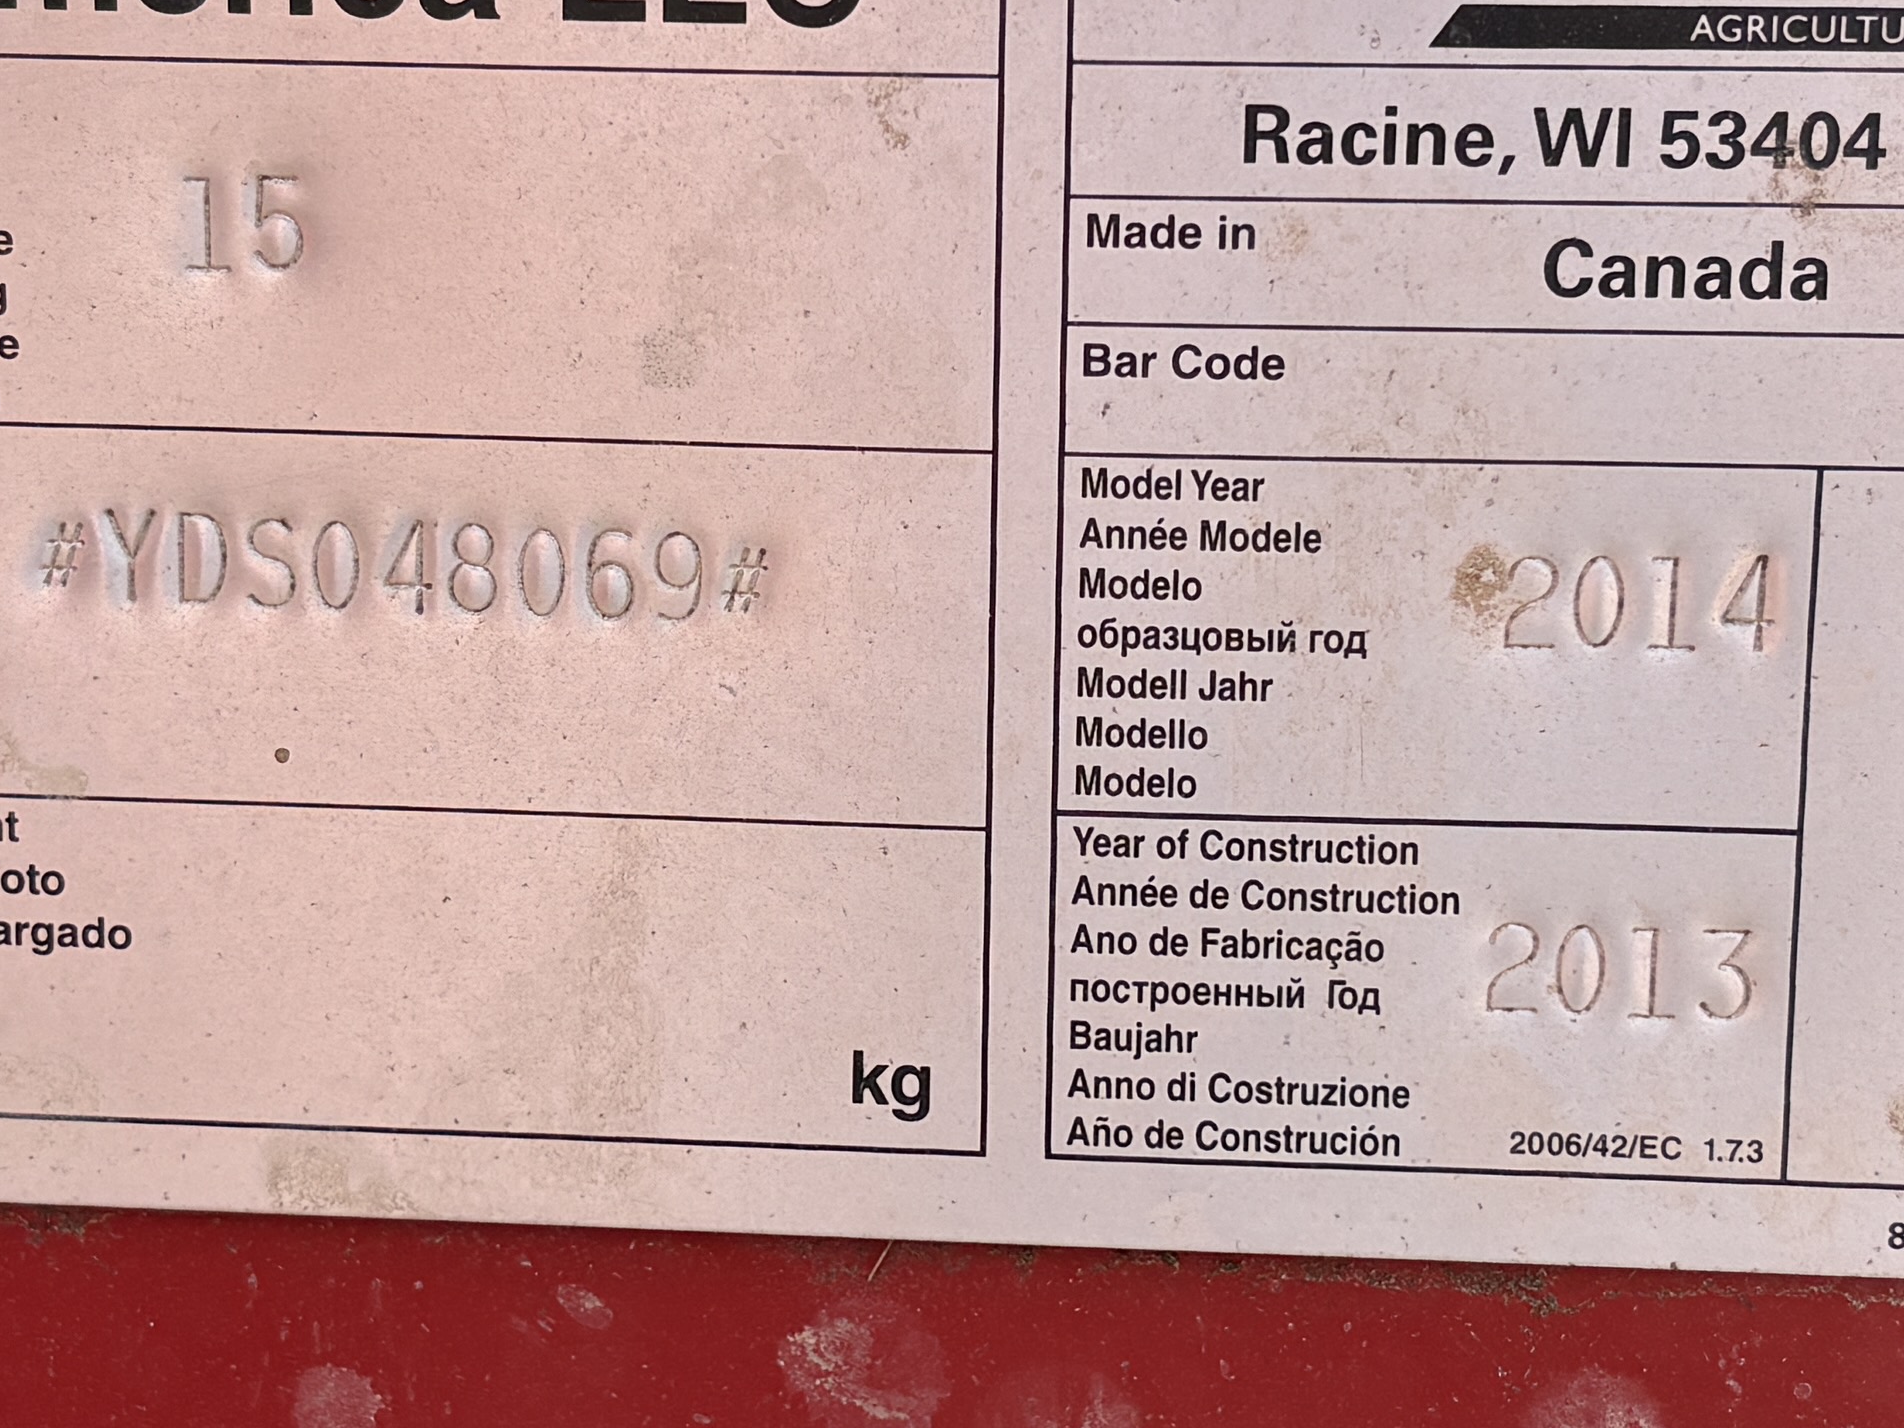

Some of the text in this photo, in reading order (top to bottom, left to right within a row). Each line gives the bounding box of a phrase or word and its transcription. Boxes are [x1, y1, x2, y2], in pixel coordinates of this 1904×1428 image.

[1242, 102, 1518, 177] Racine,
[1532, 105, 1634, 170] WI
[1658, 108, 1889, 173] 53404
[183, 174, 304, 273] 15
[1085, 211, 1257, 252] Made in
[1542, 235, 1830, 303] Canada
[1081, 341, 1287, 382] Bar Code
[1079, 462, 1267, 504] Model Year
[1077, 515, 1323, 556] Année Modele
[40, 508, 768, 620] #YDS048069#
[1077, 565, 1204, 603] Modelo
[1503, 554, 1777, 653] 2014
[1075, 615, 1372, 661] образцовый год
[1075, 664, 1275, 704] Modell Jahr
[1074, 714, 1210, 752] Modello
[1073, 762, 1198, 801] Modelo
[1071, 824, 1420, 867] Year of Construction
[1069, 873, 1461, 917] Année de Construction
[1068, 922, 1386, 972] Ano de Fabricação
[1486, 922, 1752, 1022] 2013
[1068, 975, 1382, 1017] построенный Год
[1068, 1018, 1200, 1062] Baujahr
[850, 1048, 933, 1124] kg
[1065, 1066, 1412, 1111] Anno di Costruzione
[1064, 1114, 1402, 1159] Año de Construción
[1508, 1129, 1765, 1165] 2006/42/EC 1.7.3
